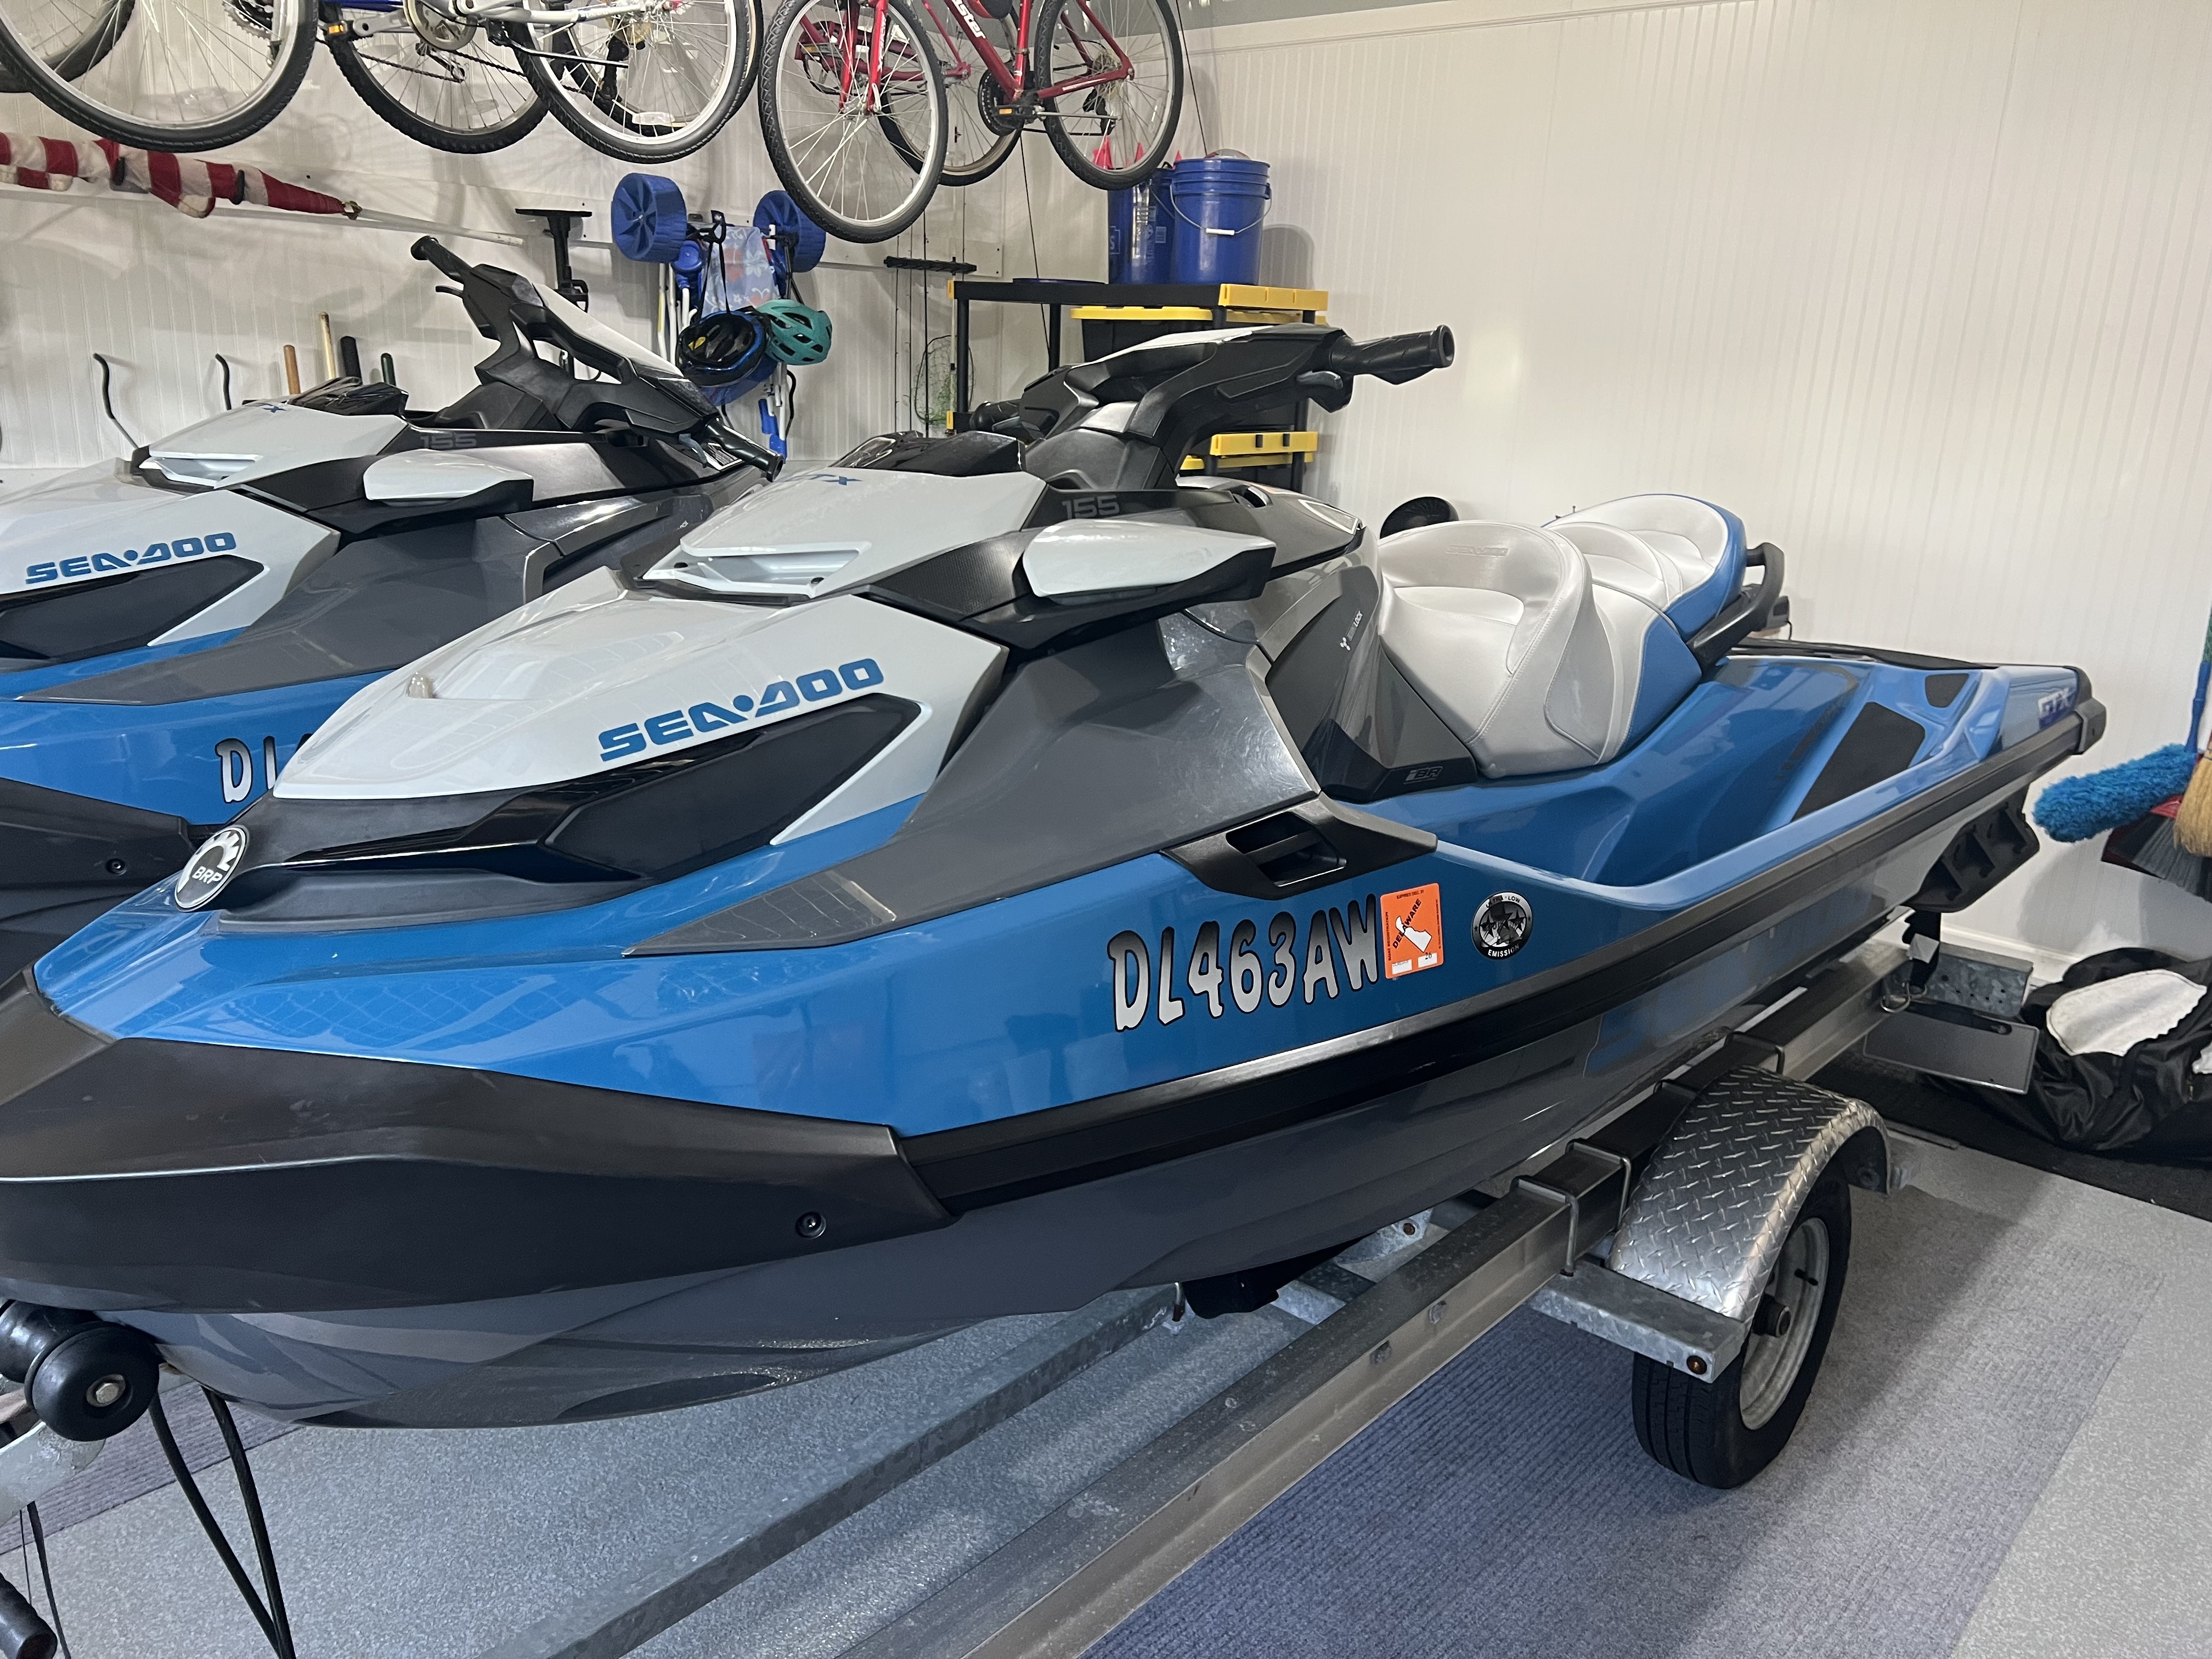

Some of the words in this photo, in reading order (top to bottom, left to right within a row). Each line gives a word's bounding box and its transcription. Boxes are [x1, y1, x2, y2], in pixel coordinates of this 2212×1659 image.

[420, 433, 477, 449] 155
[1062, 494, 1120, 519] 155
[215, 733, 314, 804] DL
[192, 866, 223, 884] BRP
[1508, 895, 1521, 904] LOW
[1392, 898, 1422, 949] DELAWARE
[1425, 952, 1432, 960] 26
[1488, 944, 1520, 957] EMISSION
[1107, 893, 1379, 1032] DL463AW
